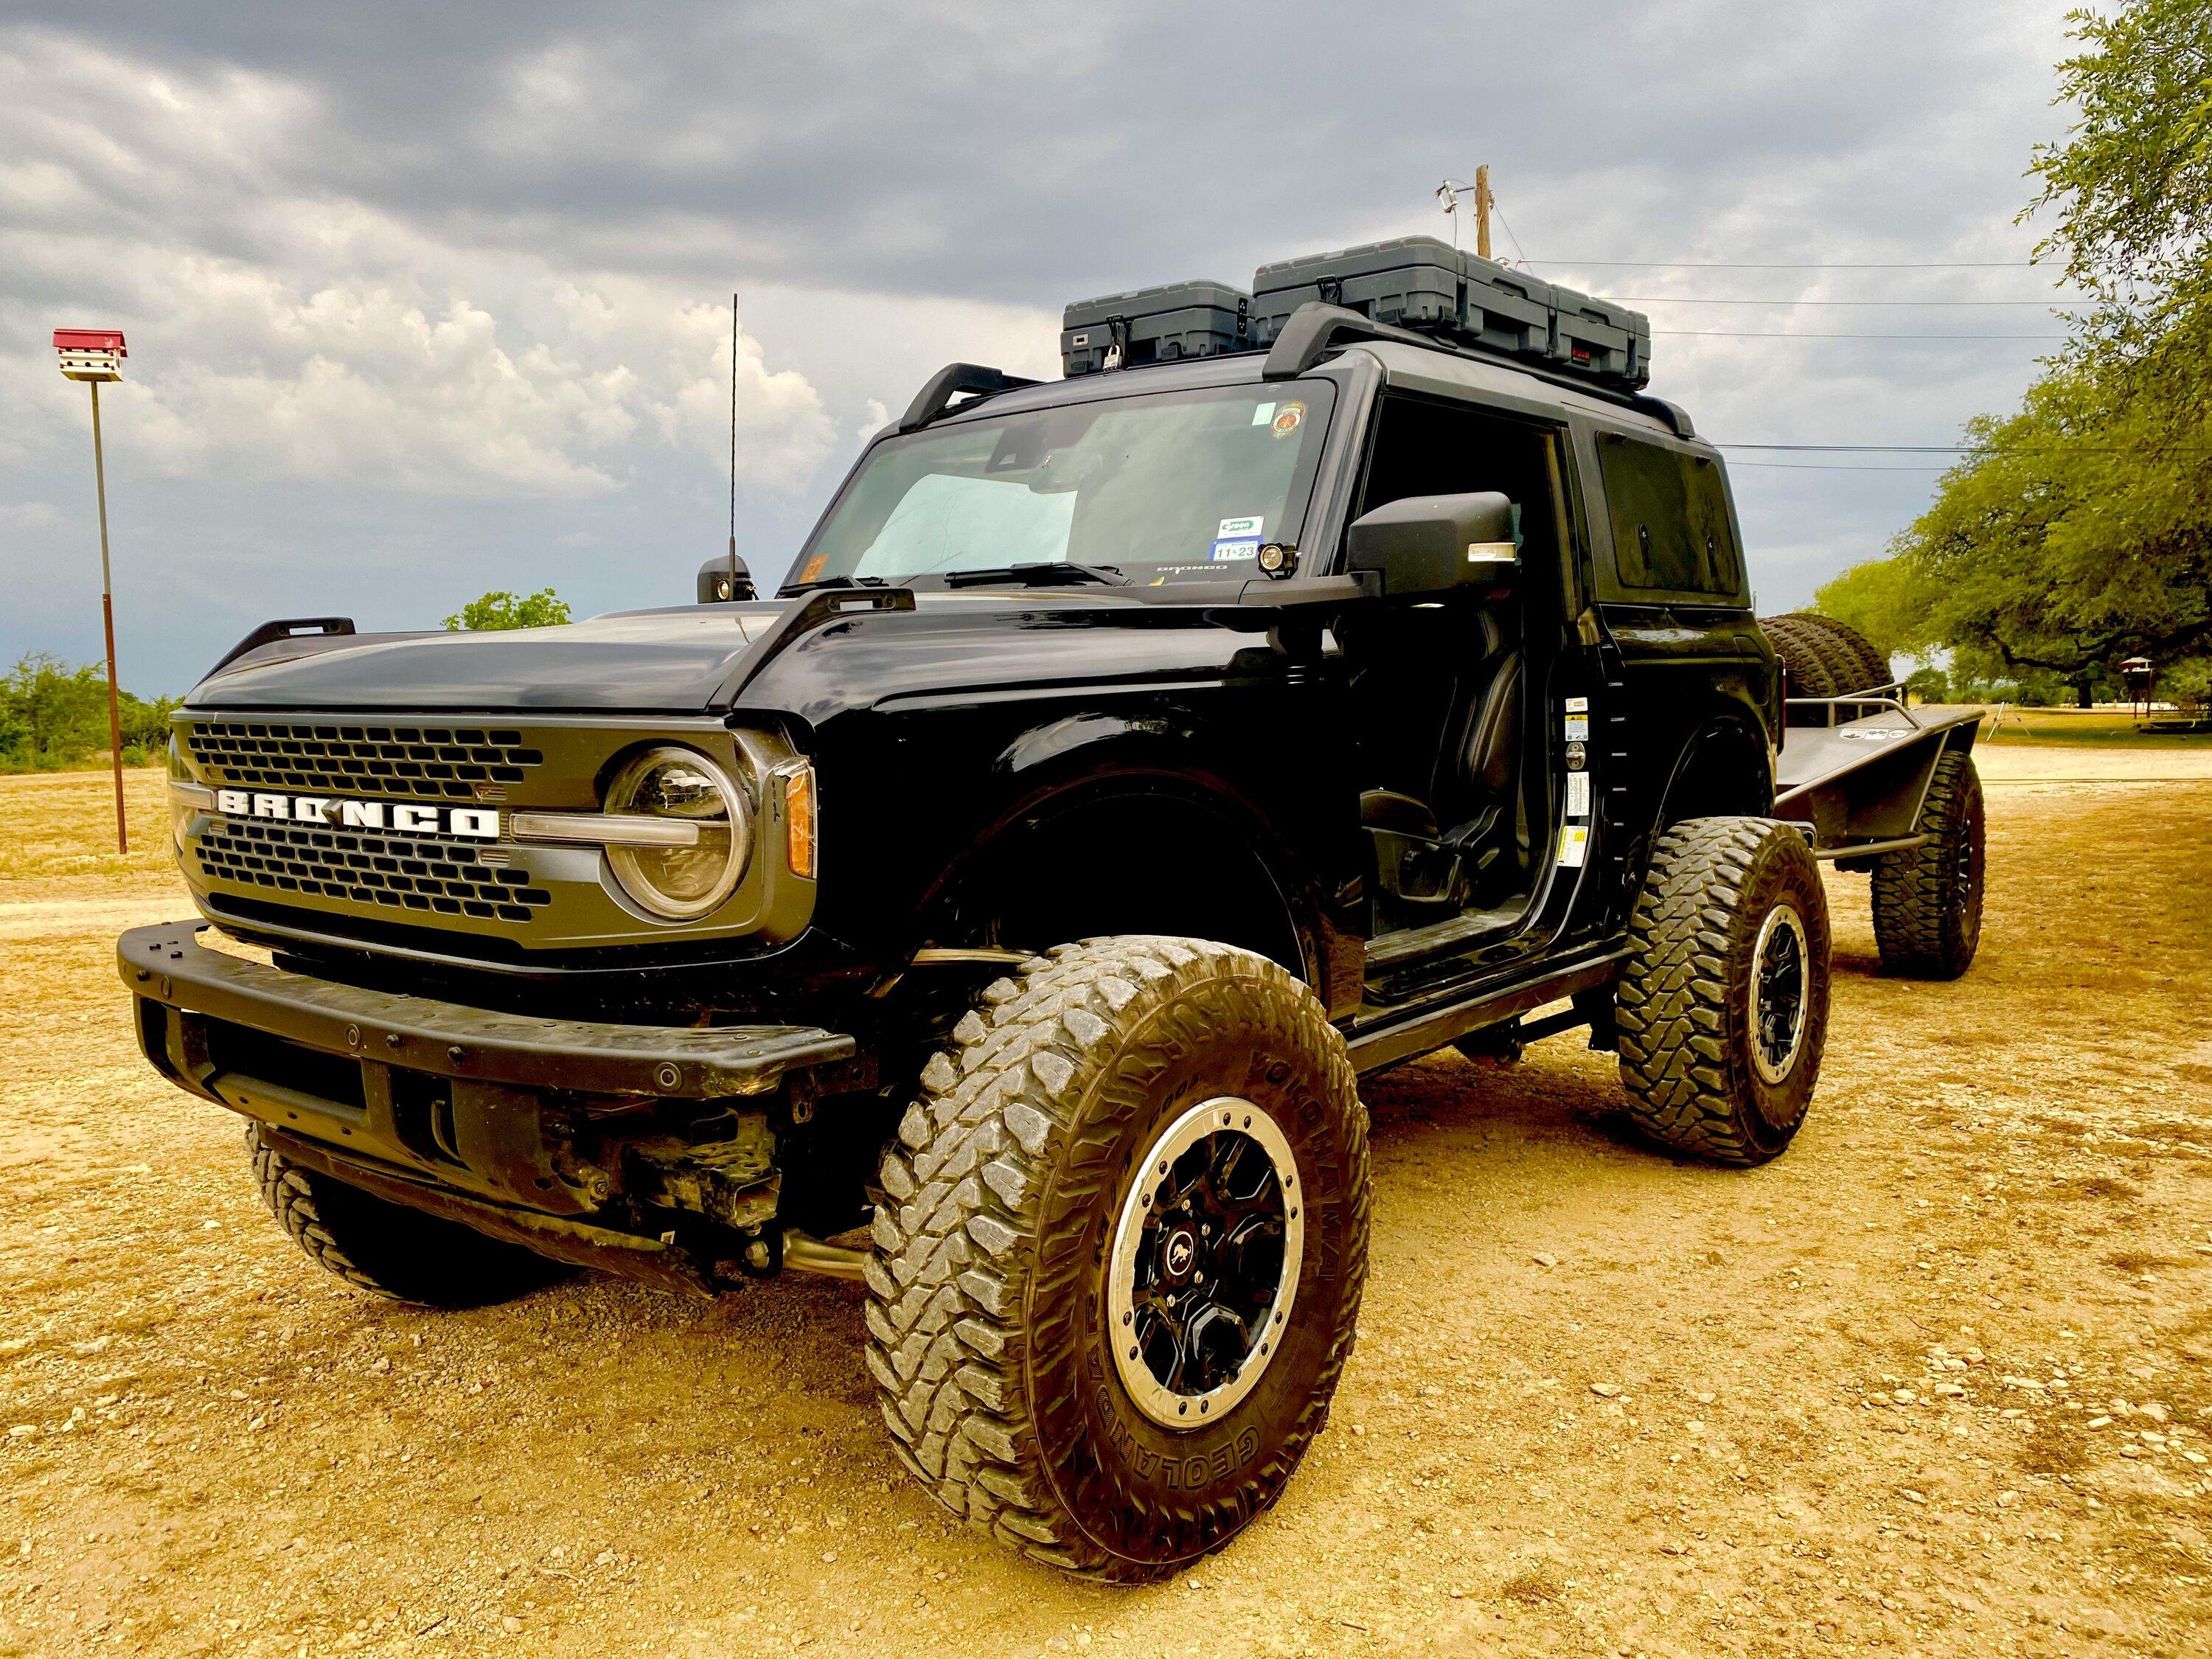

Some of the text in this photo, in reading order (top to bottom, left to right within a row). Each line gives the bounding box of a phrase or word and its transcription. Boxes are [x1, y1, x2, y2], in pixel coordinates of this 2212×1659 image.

[218, 789, 500, 838] BRONCO
[1246, 1051, 1343, 1281] YOKOHAMA
[1085, 1293, 1261, 1491] GEOLANDAR
